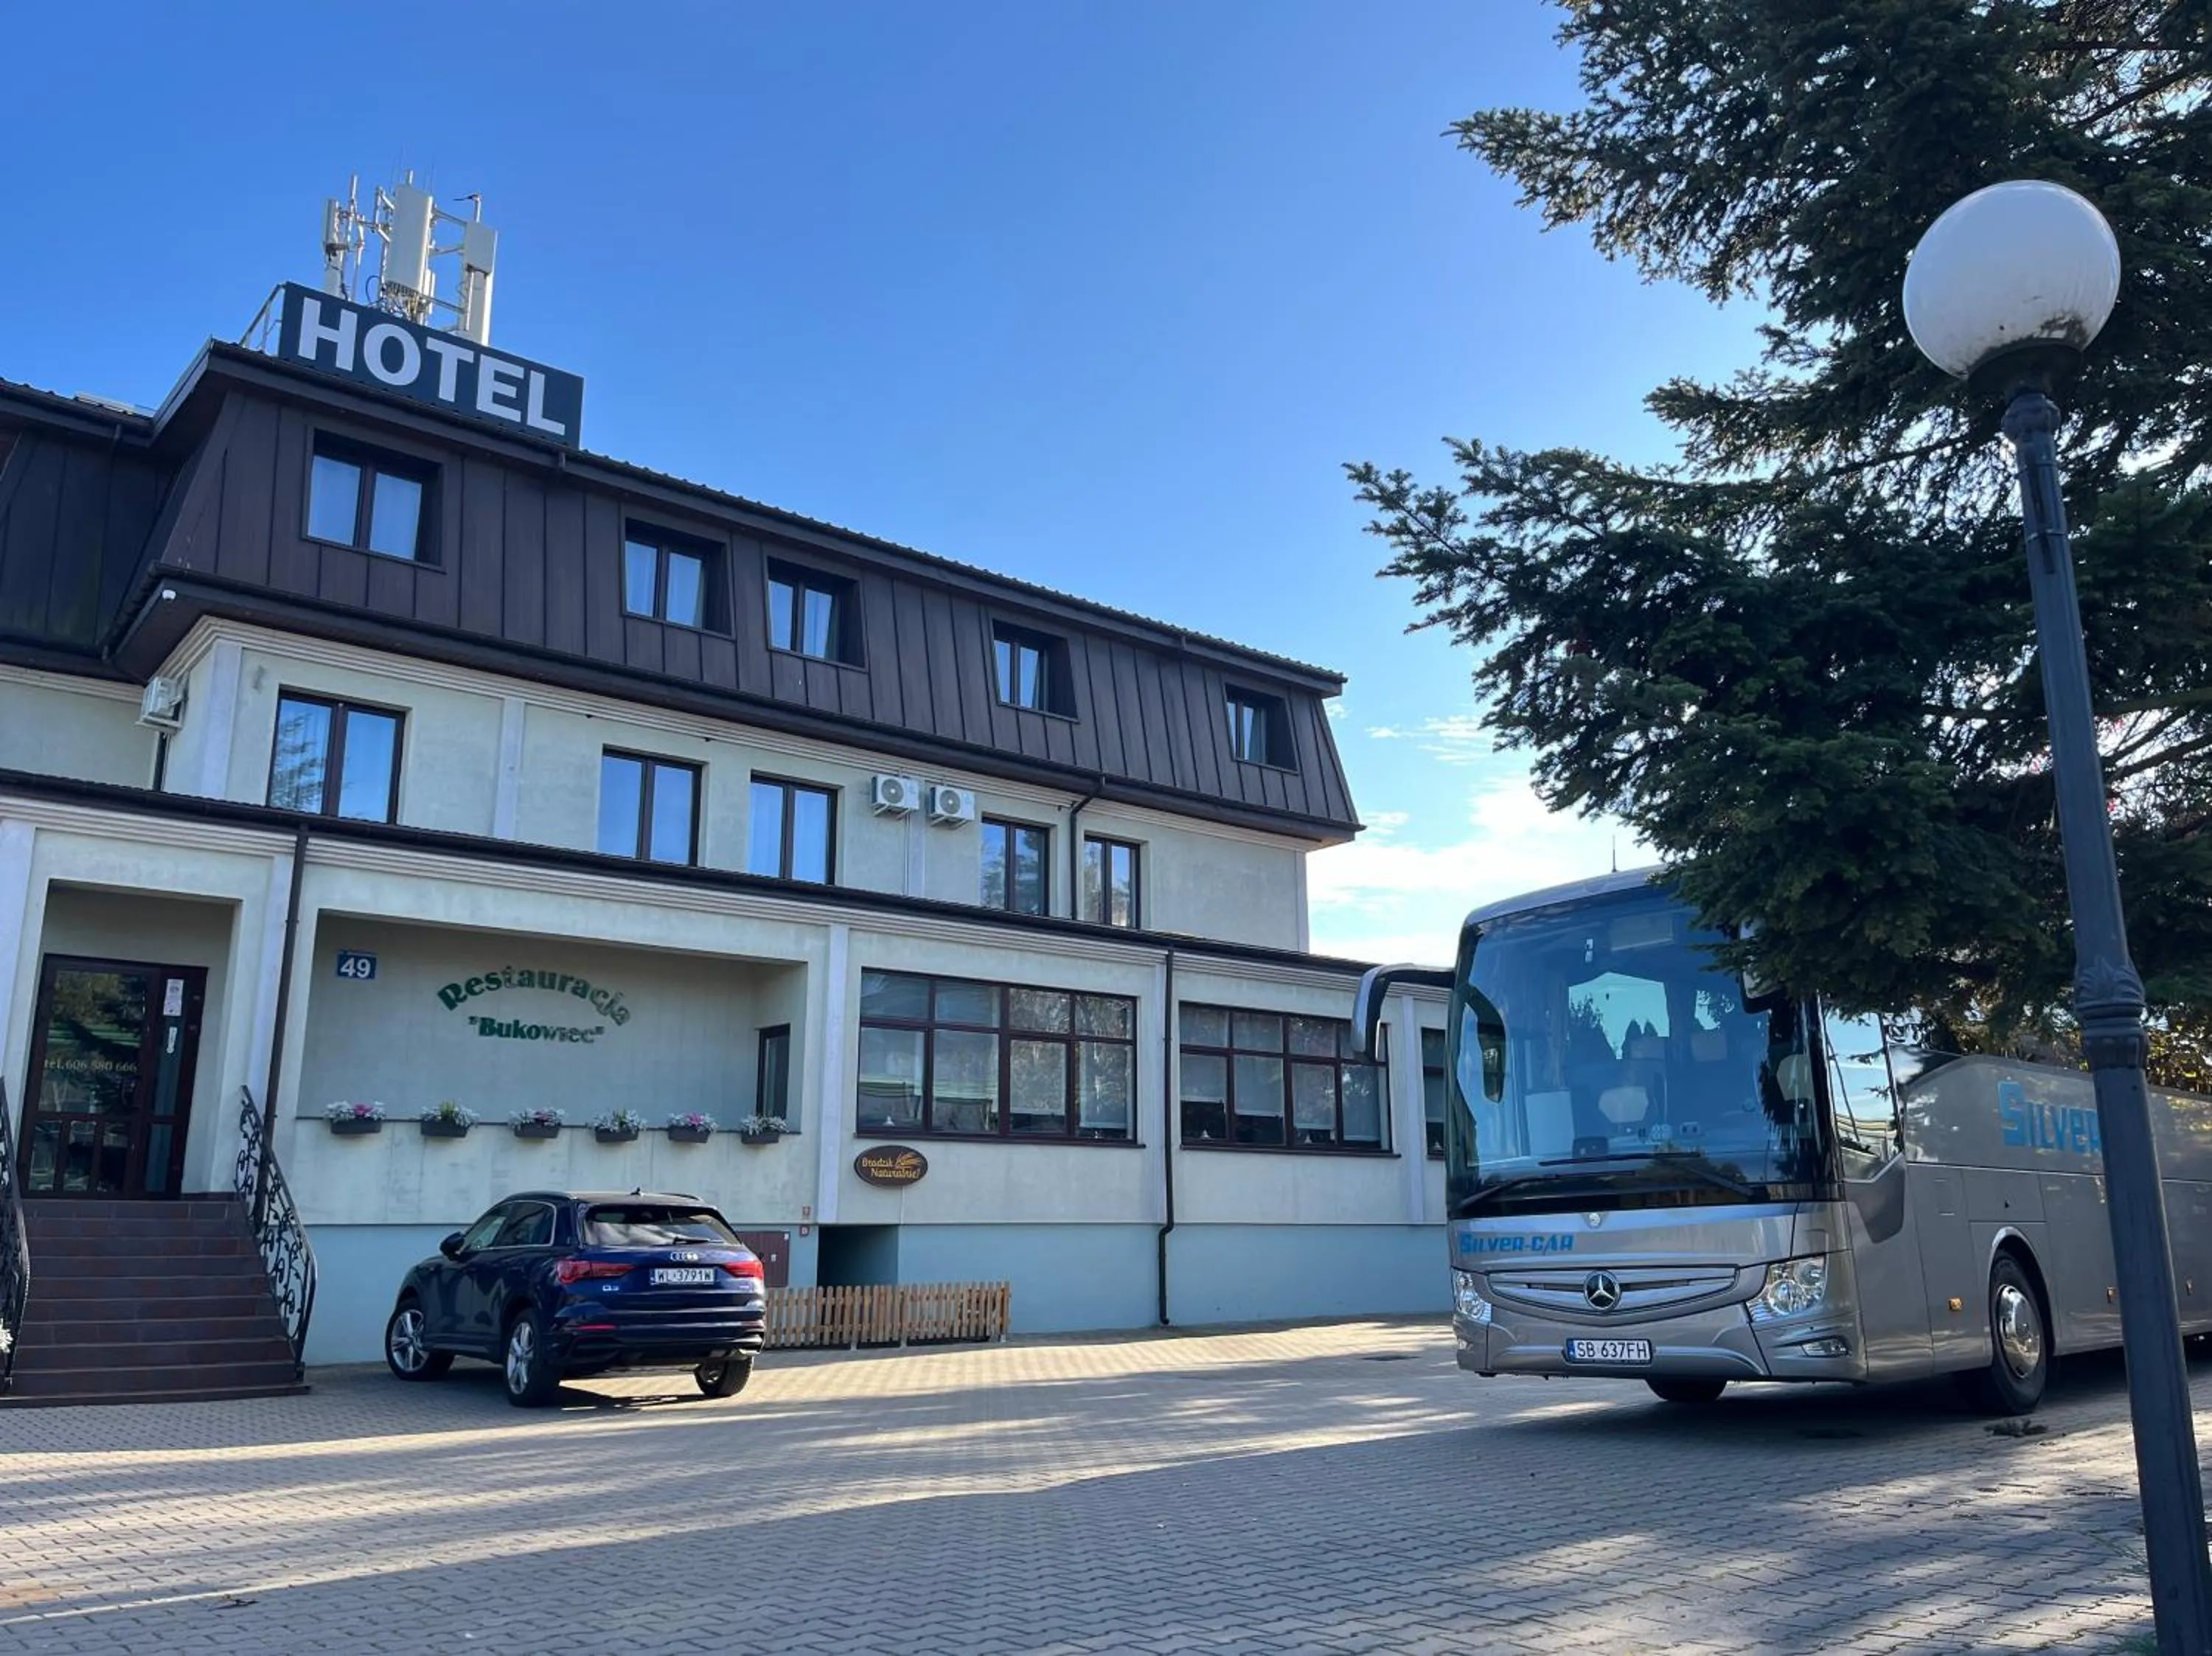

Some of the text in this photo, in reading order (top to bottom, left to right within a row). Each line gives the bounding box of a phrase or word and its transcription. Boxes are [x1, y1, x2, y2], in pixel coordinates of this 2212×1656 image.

[298, 296, 566, 436] HOTEL
[340, 957, 371, 978] 49
[437, 965, 630, 1026] Restauracja
[657, 1269, 669, 1282] WL
[1576, 1341, 1647, 1359] SB 637FH
